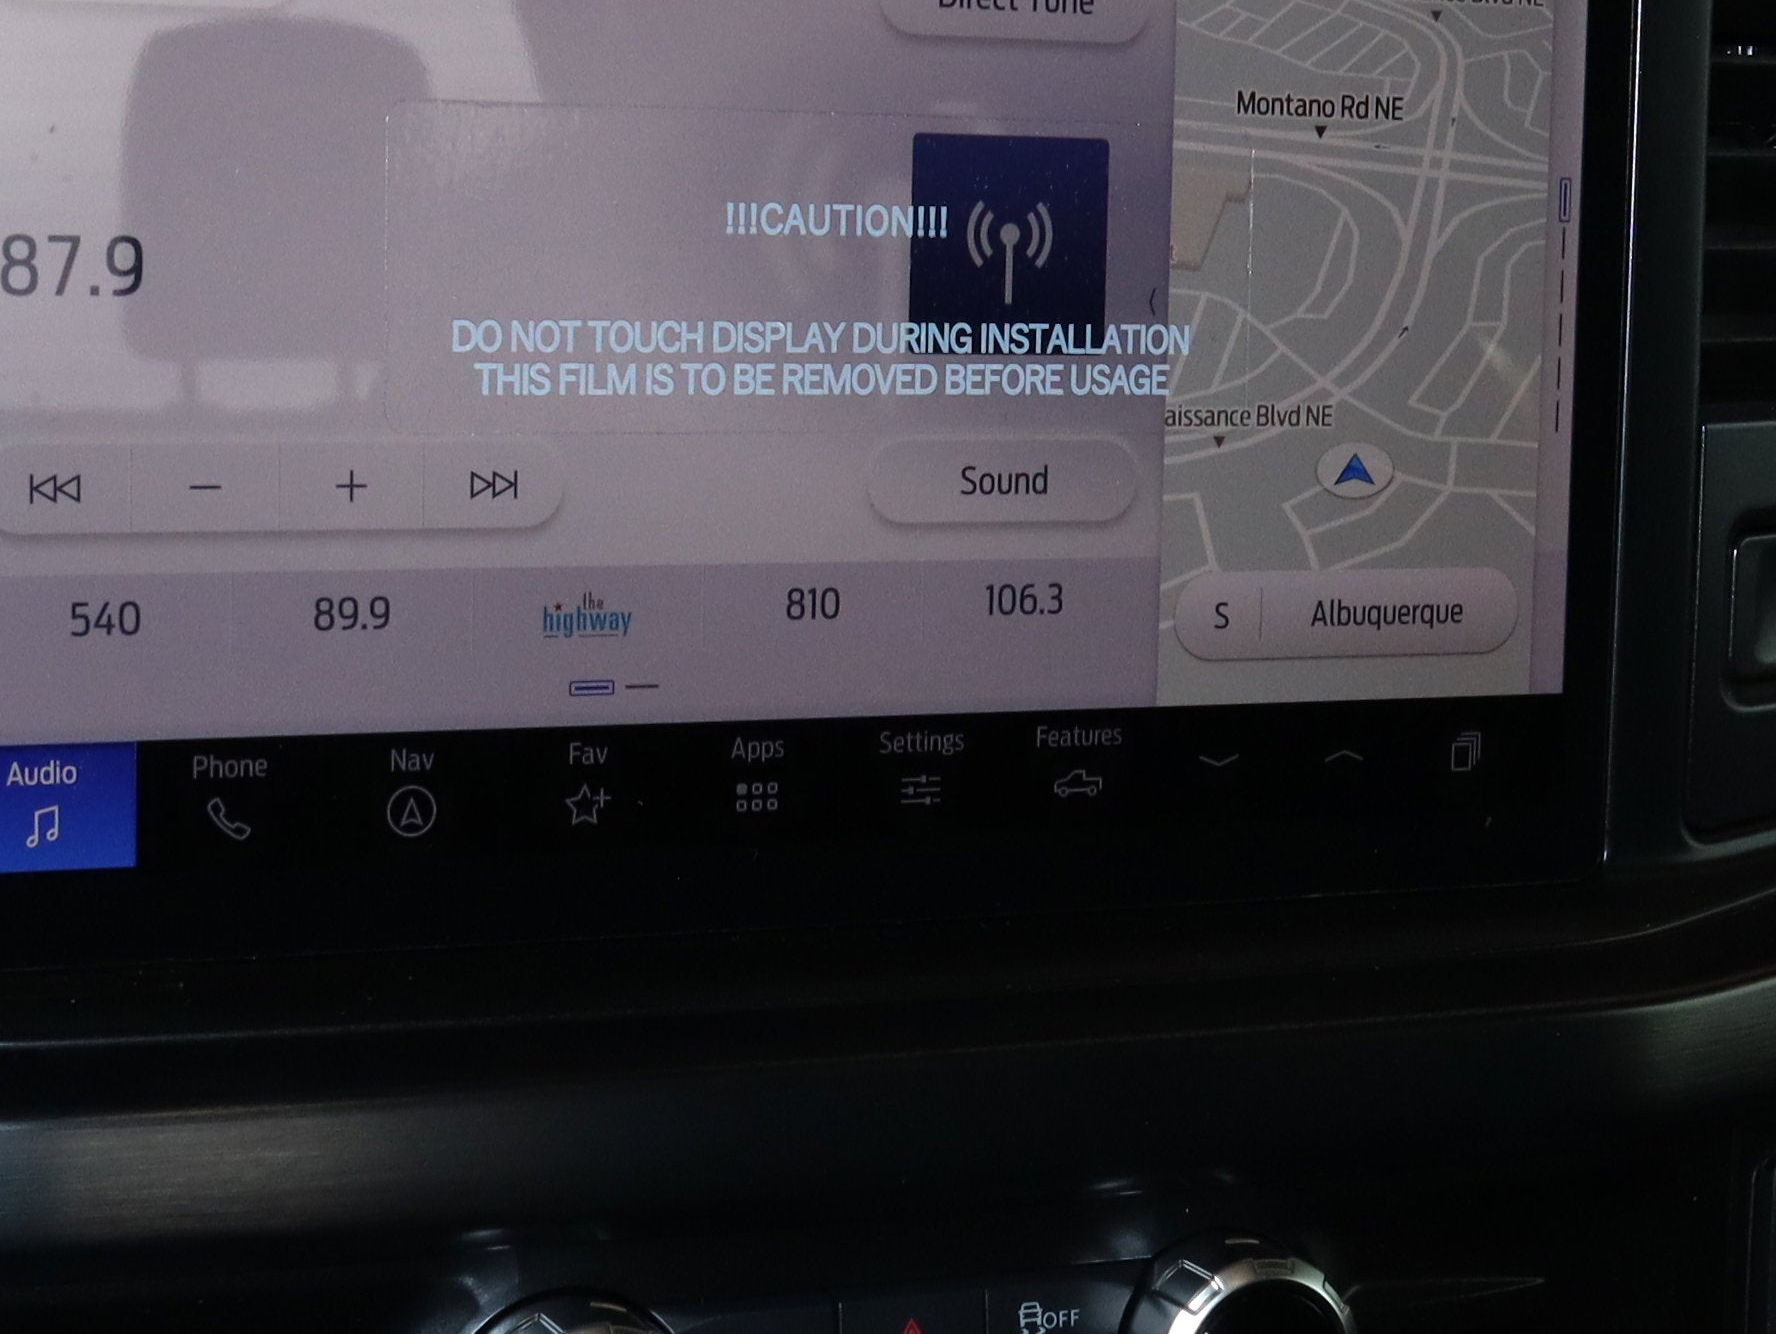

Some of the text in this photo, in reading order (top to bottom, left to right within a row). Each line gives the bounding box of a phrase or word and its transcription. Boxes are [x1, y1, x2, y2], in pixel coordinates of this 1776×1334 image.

[1236, 90, 1405, 121] Montano Rd NE
[724, 201, 948, 239] !!!CAUTION!!!
[0, 232, 144, 298] 87.9
[452, 318, 1191, 356] DO NOT TOUCH DISPLAY DURING INSTALLATION
[473, 362, 1170, 397] THIS FILM IS TO BE REMOVED BEFORE USAGE
[1256, 404, 1301, 427] Blvd
[1305, 405, 1334, 427] NE
[959, 464, 1049, 497] Sound
[312, 596, 392, 631] 89.9
[581, 591, 605, 612] the
[784, 587, 841, 621] 810
[984, 583, 1065, 617] 106.3
[1311, 599, 1464, 631] Albuquerque
[69, 600, 141, 637] 540
[542, 606, 633, 638] highway
[1213, 602, 1230, 630] S
[731, 736, 785, 762] Apps
[879, 730, 965, 757] Settings
[1035, 725, 1123, 749] Features
[191, 754, 268, 780] Phone
[389, 748, 435, 773] Nav
[568, 742, 608, 767] Fav
[6, 761, 78, 788] Audio
[1041, 1306, 1081, 1331] OFF
